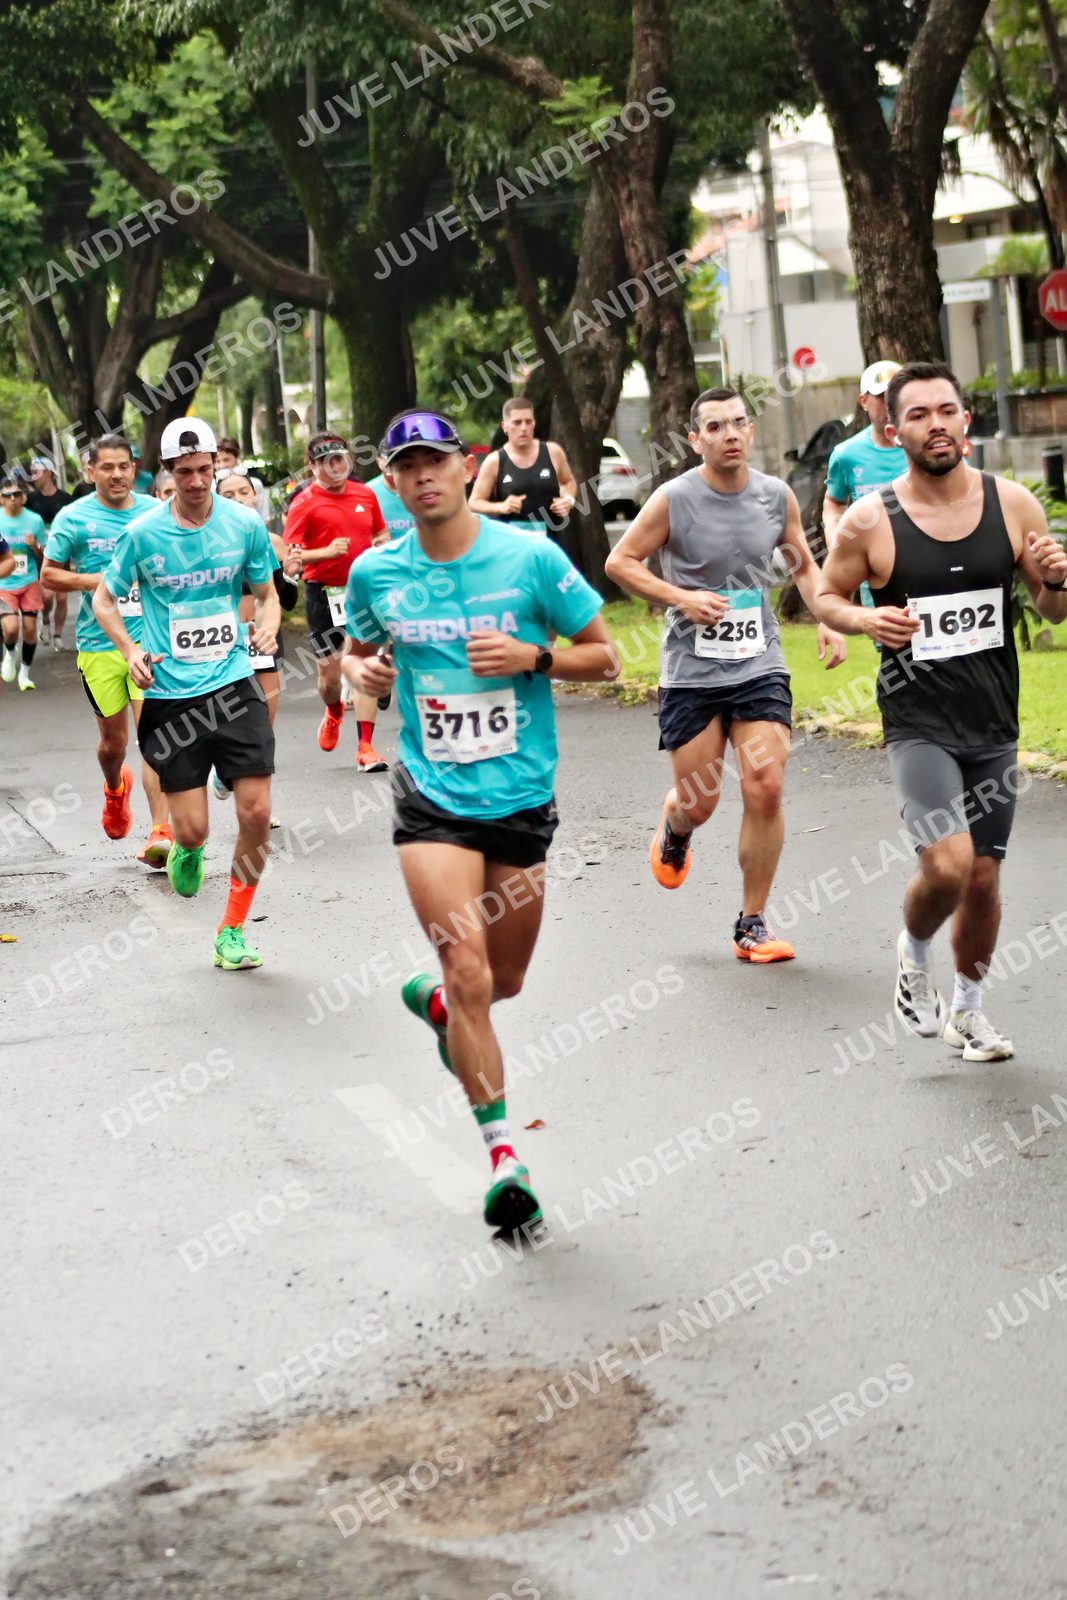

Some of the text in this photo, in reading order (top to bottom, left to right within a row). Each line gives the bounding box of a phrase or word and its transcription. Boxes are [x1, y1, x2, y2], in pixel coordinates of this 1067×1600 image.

[385, 611, 518, 643] PERDURA
[701, 620, 758, 643] 3236
[919, 603, 996, 638] 1692
[176, 625, 234, 650] 6228
[424, 706, 509, 740] 3716
